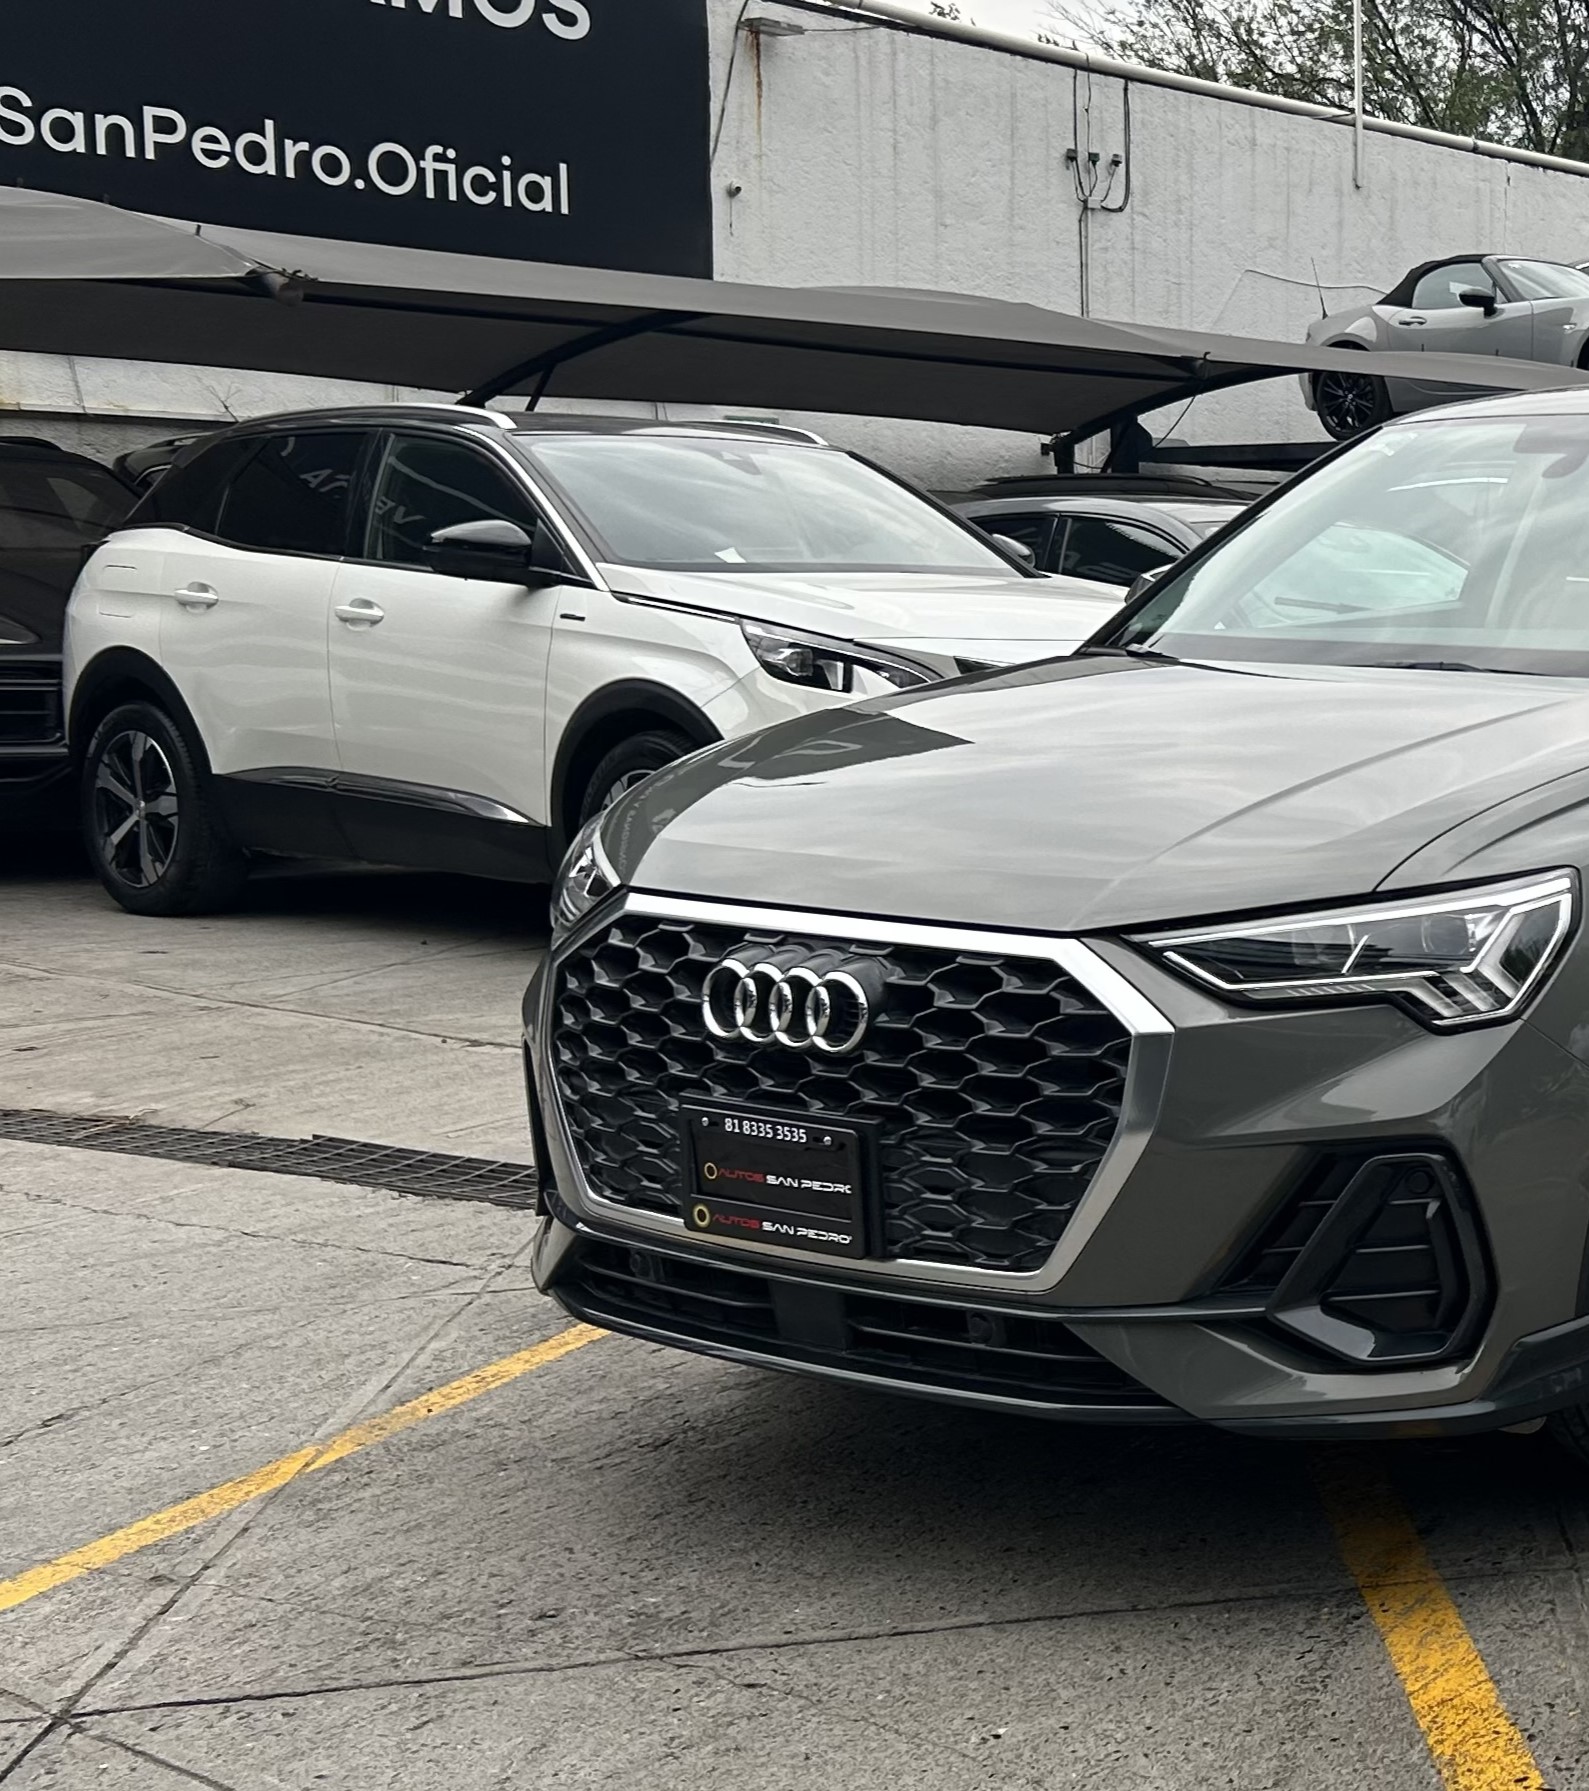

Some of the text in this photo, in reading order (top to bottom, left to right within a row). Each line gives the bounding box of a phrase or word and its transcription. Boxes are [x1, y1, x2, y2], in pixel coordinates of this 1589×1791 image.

[0, 86, 571, 216] SanPedro.Oficial
[724, 1117, 808, 1143] 81 8335 3535
[718, 1167, 765, 1183] AUTOS
[766, 1174, 799, 1188] SAN
[712, 1213, 850, 1244] AUTOS SAN PEDRO
